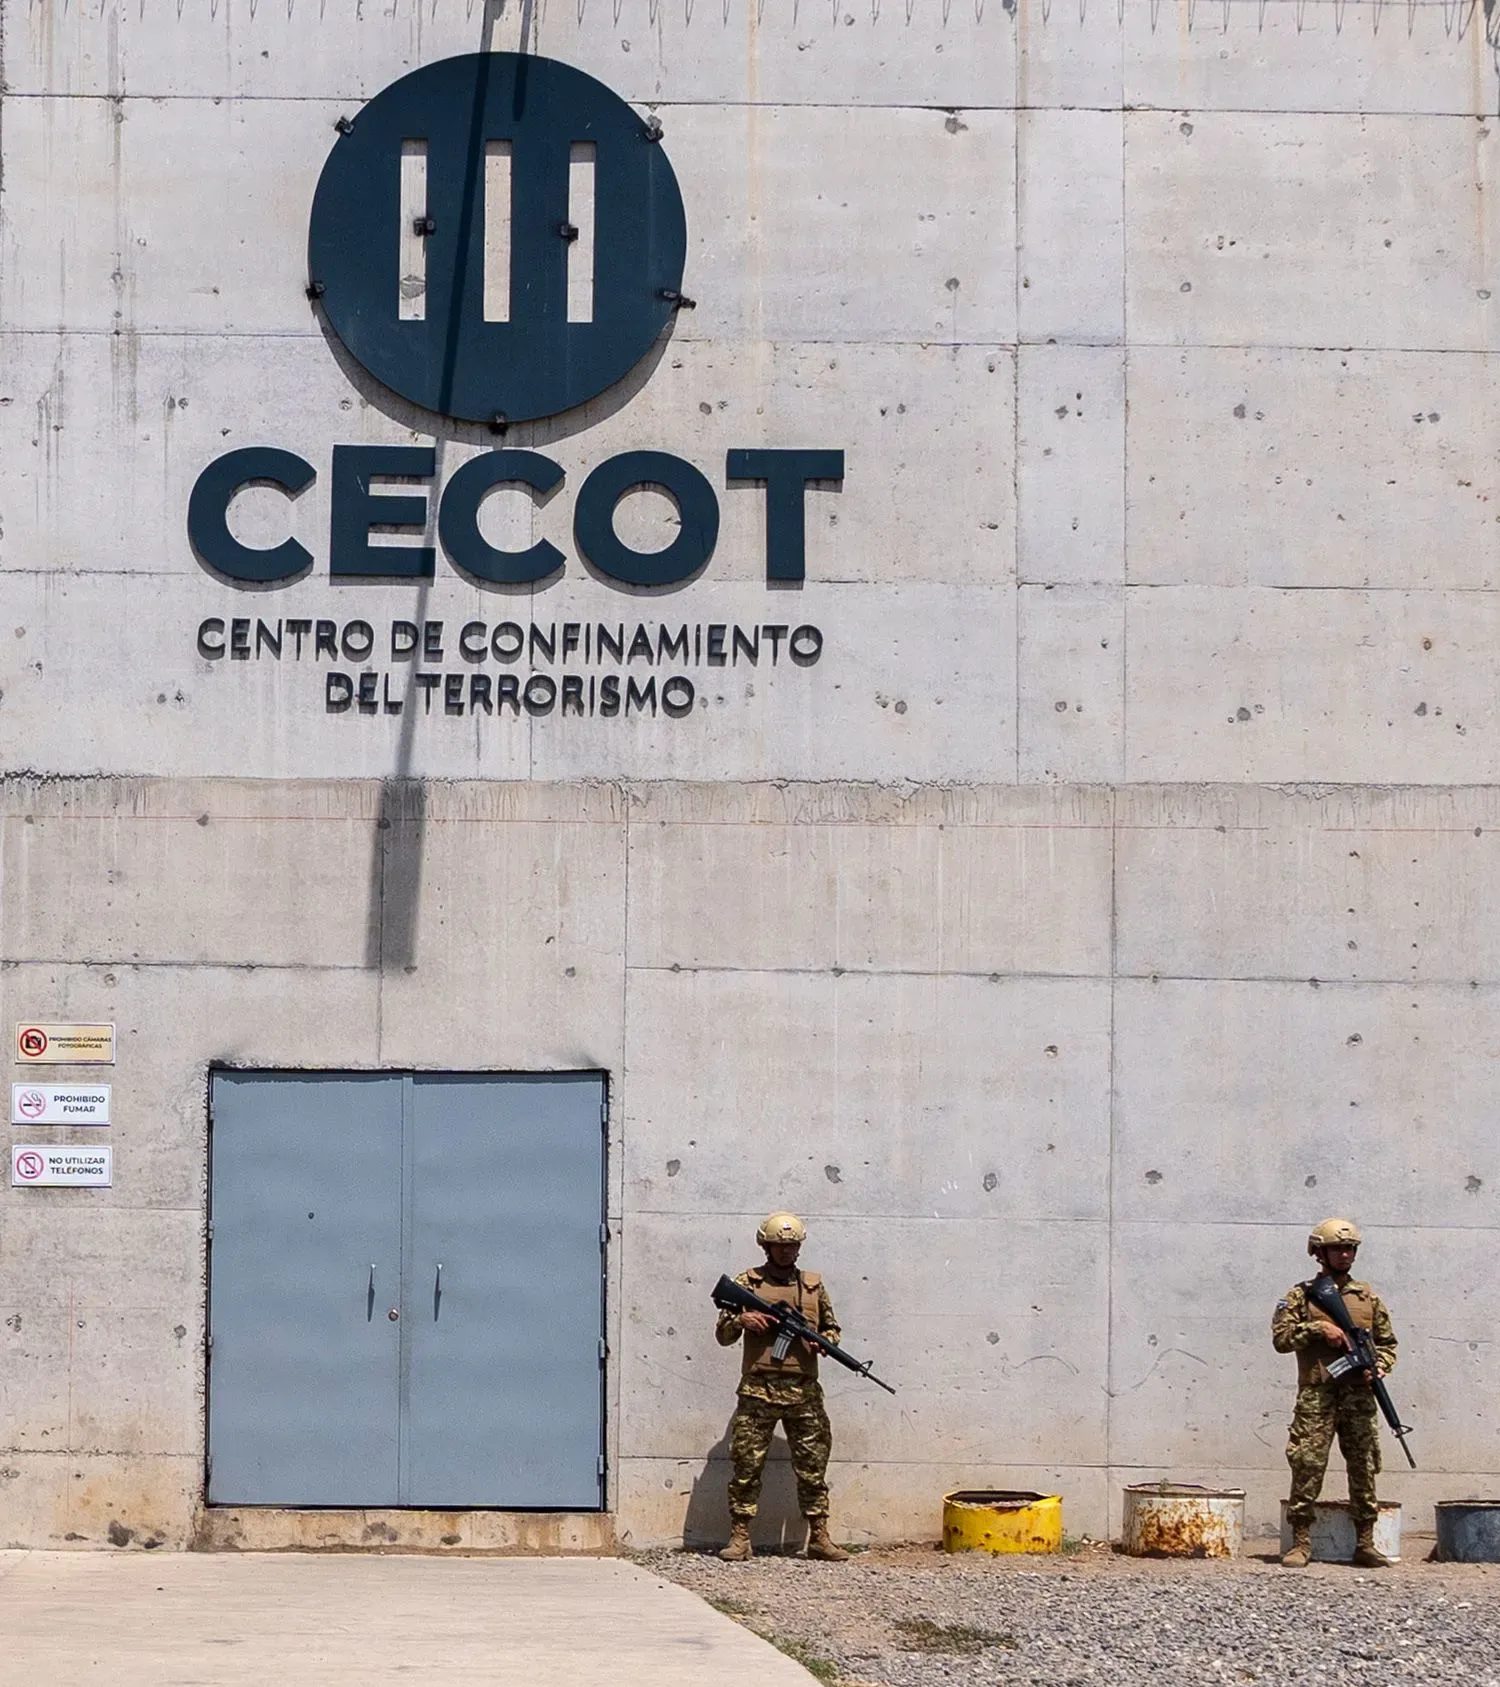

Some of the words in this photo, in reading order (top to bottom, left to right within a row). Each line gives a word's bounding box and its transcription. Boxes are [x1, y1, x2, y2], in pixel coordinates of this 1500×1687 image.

[187, 443, 845, 587] CECOT
[197, 617, 374, 661] CENTRO
[391, 619, 444, 662] DE
[460, 620, 825, 668] CONFINAMIENTO
[326, 672, 401, 715] DEL
[415, 673, 696, 718] TERRORISMO
[54, 1095, 105, 1103] PROHIBIDO
[63, 1105, 96, 1113] FUMAR
[49, 1157, 63, 1165] NO
[65, 1157, 106, 1165] UTILIZAR
